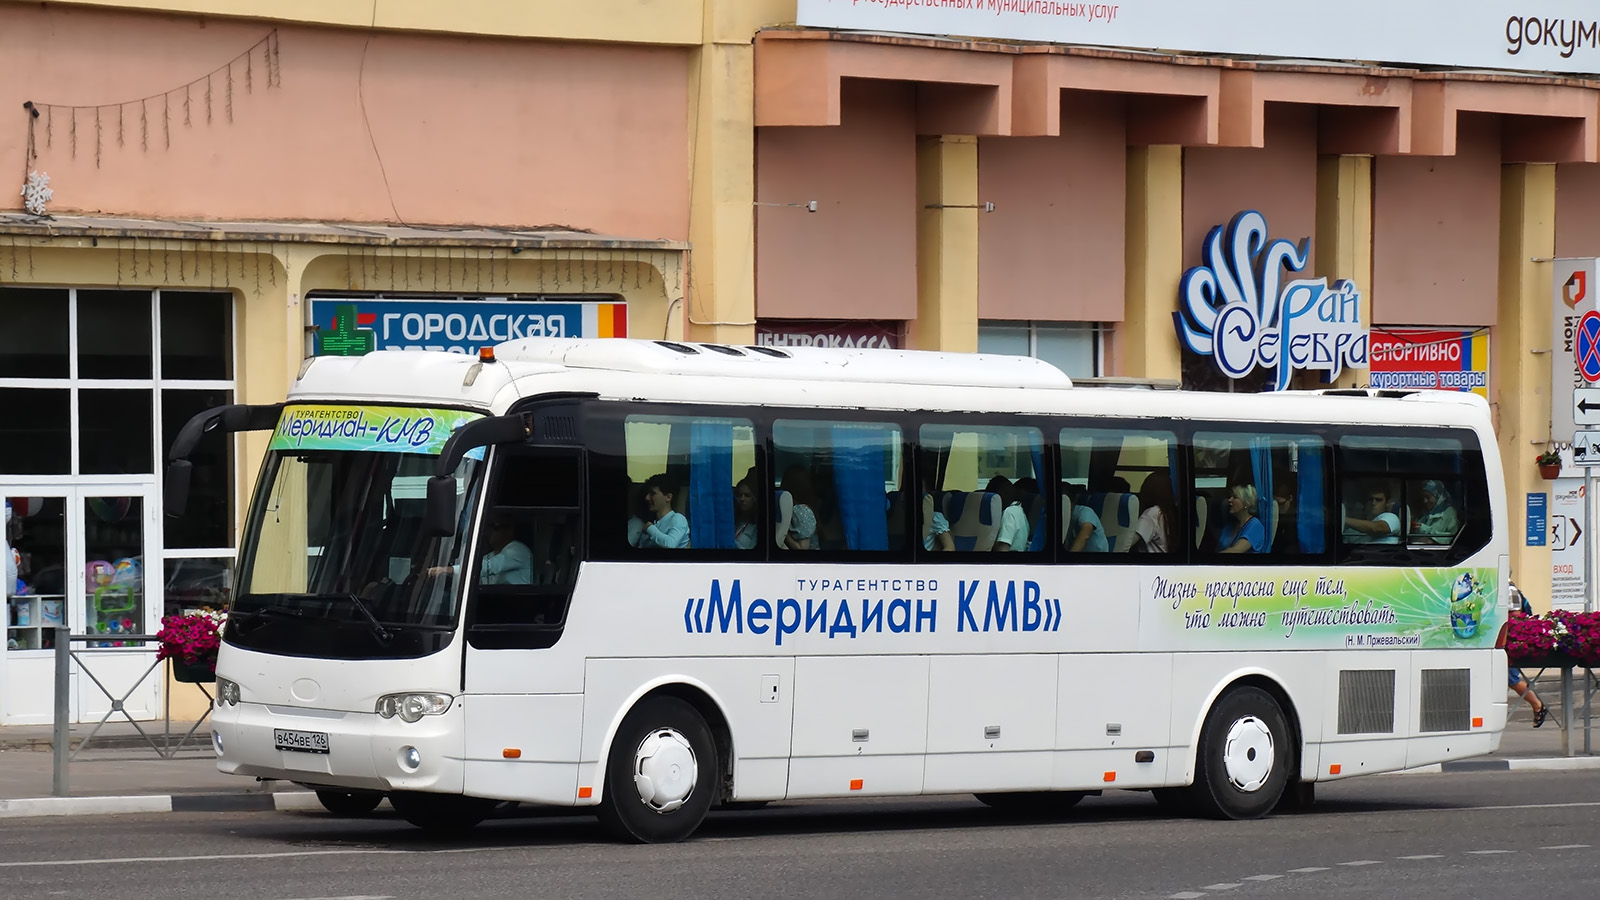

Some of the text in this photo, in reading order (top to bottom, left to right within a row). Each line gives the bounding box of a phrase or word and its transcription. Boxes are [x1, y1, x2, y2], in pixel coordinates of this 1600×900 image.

[864, 0, 973, 9] урвенных
[987, 0, 1086, 17] муниципальных
[1088, 4, 1119, 23] услуг
[1505, 15, 1600, 59] докум
[1371, 342, 1460, 361] СПОРТИВНО
[1370, 372, 1485, 391] курортные товары
[296, 410, 359, 419] ТУРАГЕНТСТВО
[1553, 564, 1574, 575] ВХОД
[798, 579, 938, 591] ТУРАГЕНТСТВО
[1151, 575, 1347, 609] Жизнь прекрасна еще тем,
[684, 579, 1062, 645] «Меридиан КМВ»
[1184, 600, 1398, 639] что можно путешествовать.
[1366, 634, 1421, 647] Пржевальский)
